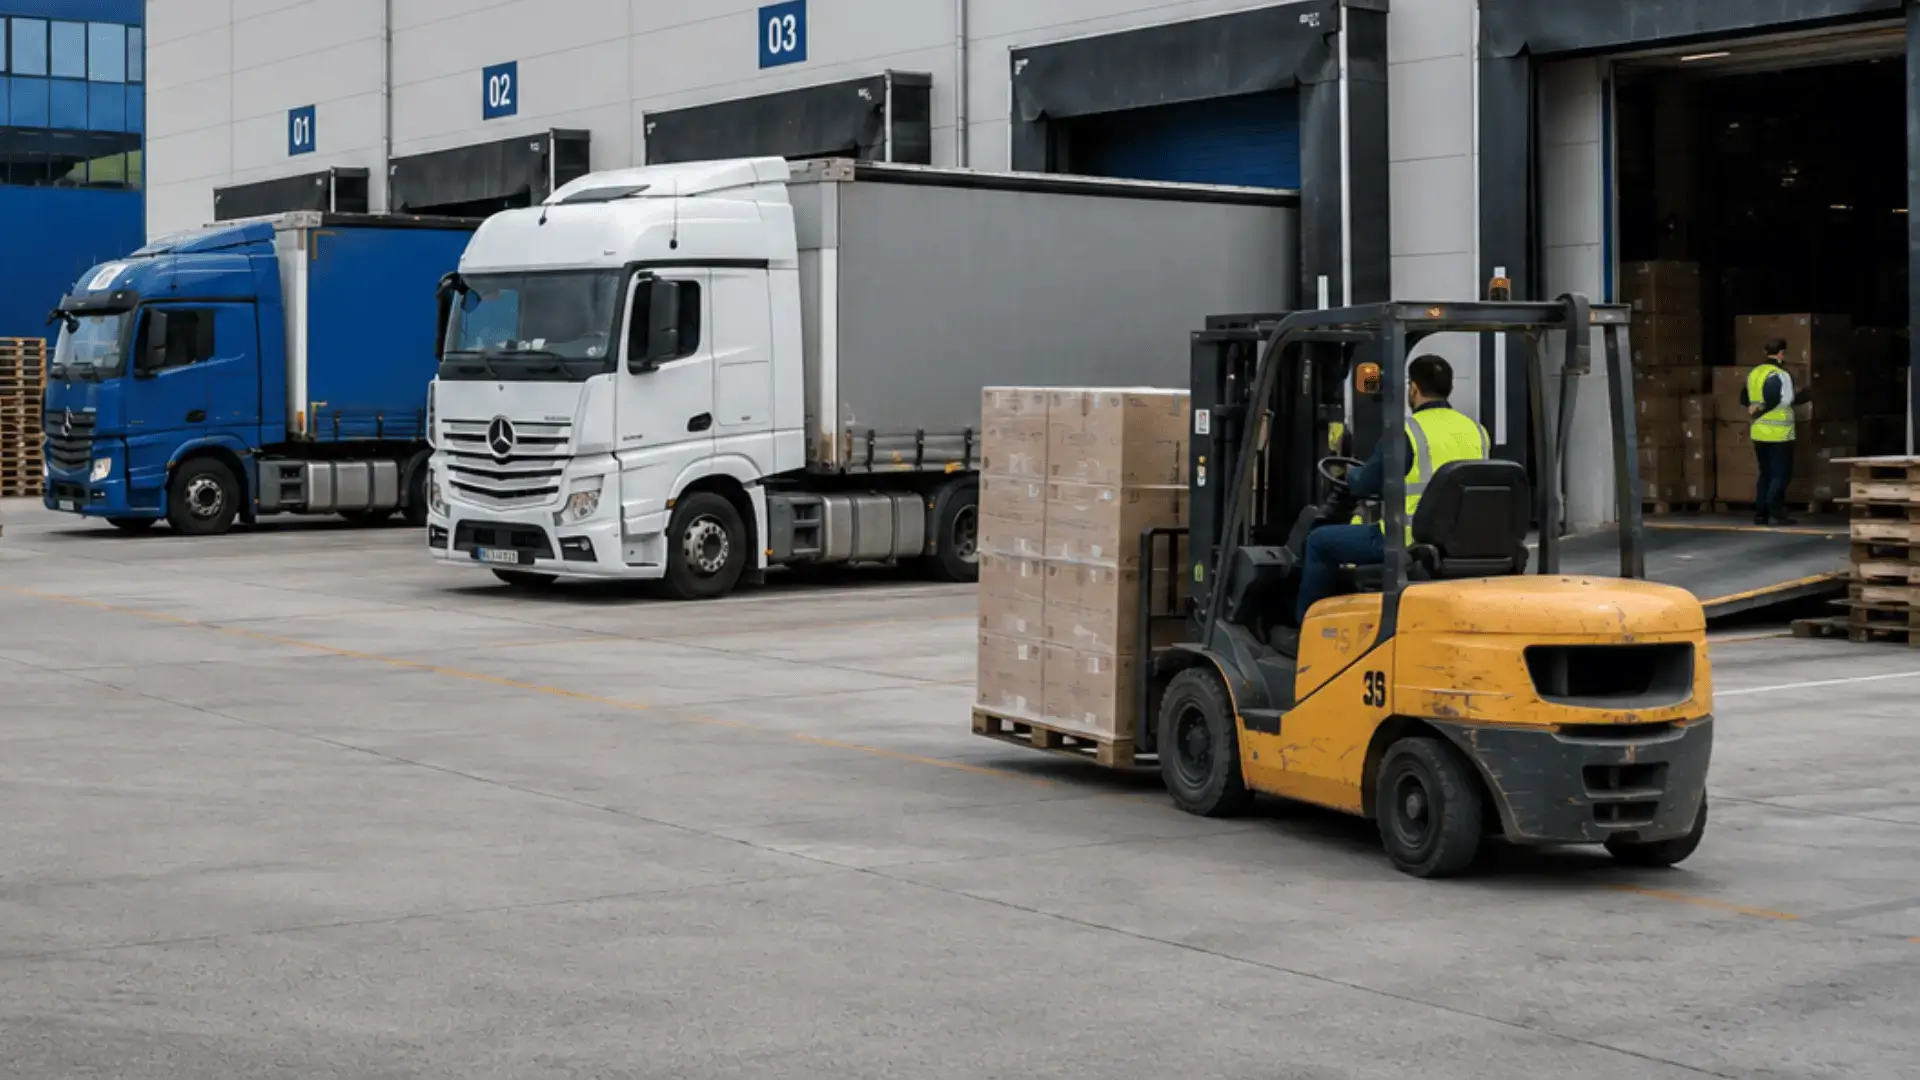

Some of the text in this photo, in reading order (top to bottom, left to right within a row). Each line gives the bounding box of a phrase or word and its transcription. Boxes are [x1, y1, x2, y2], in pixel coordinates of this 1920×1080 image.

[768, 14, 797, 54] 03
[490, 73, 511, 107] 02
[294, 116, 310, 145] 01
